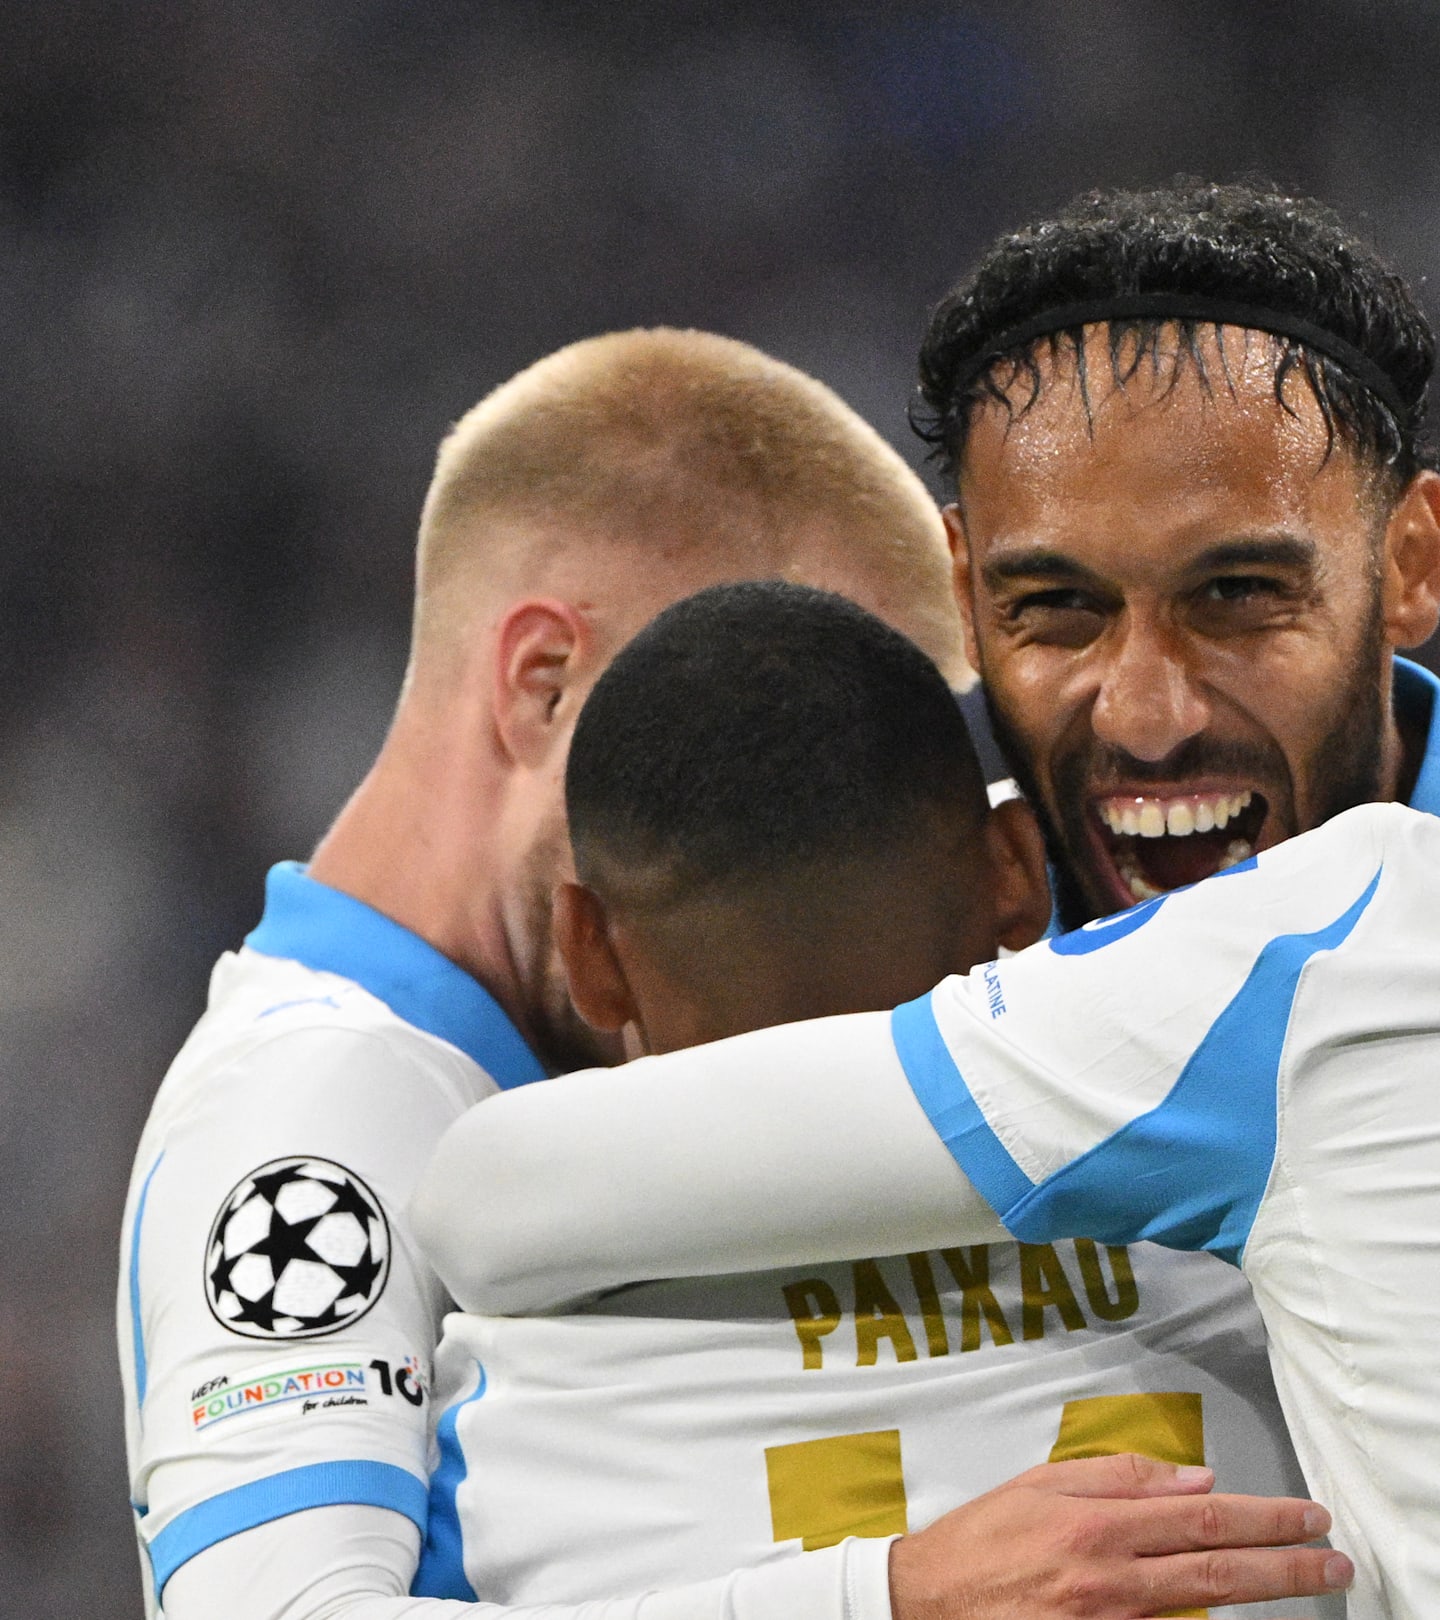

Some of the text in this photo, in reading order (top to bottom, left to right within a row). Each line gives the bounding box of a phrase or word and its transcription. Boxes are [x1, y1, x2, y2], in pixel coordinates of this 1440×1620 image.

[191, 1375, 230, 1401] UEFA
[192, 1369, 366, 1426] FOUNDATION
[302, 1396, 368, 1415] for children
